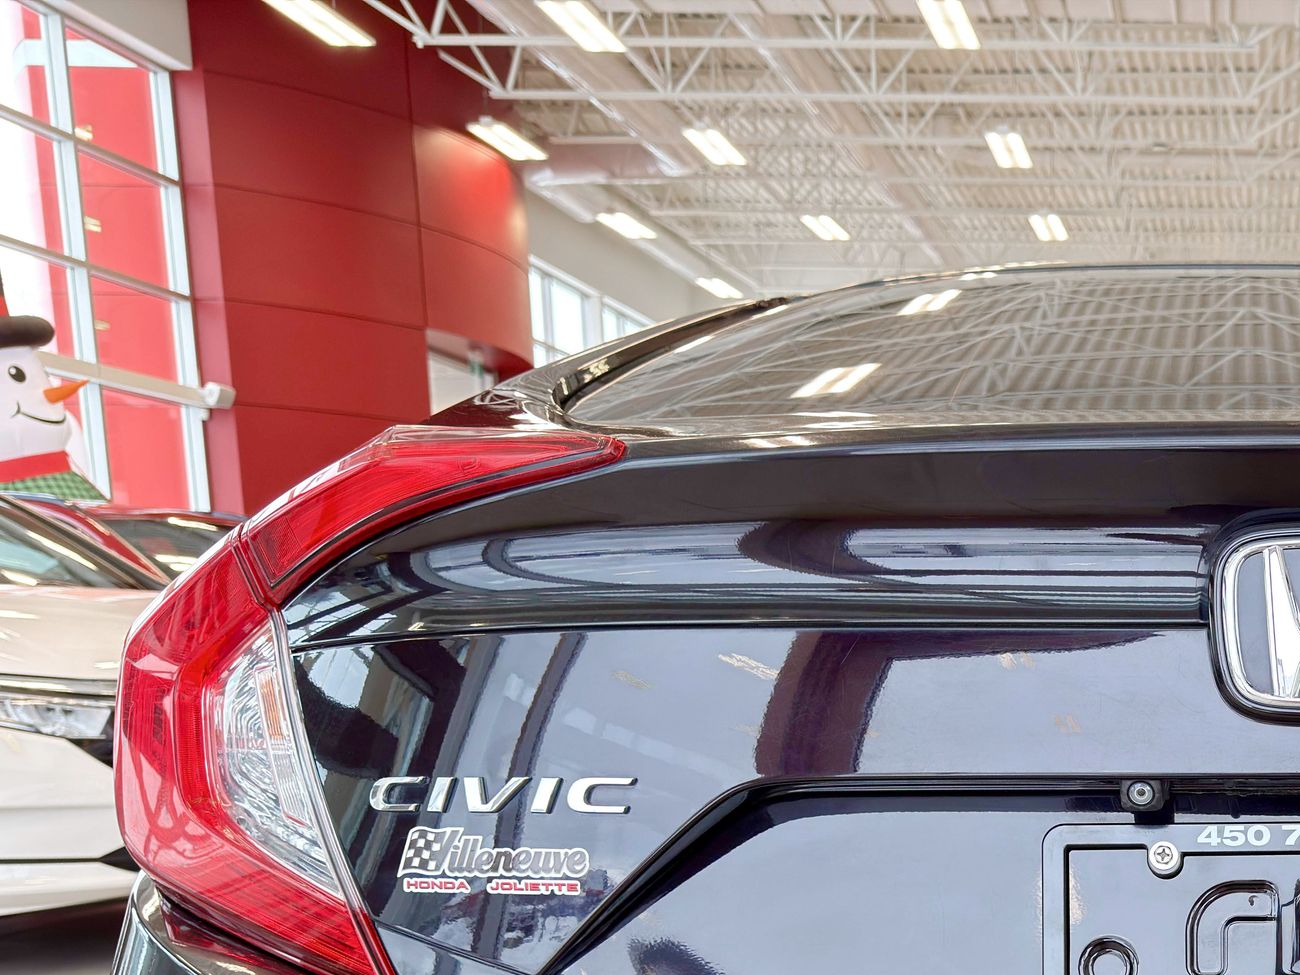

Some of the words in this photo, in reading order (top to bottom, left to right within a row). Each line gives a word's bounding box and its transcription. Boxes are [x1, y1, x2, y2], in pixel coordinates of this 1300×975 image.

[369, 776, 638, 814] CIVIC
[1197, 824, 1271, 847] 450
[400, 827, 589, 877] Villeneuve
[405, 879, 470, 893] HONDA
[489, 880, 581, 894] JOLIETTE
